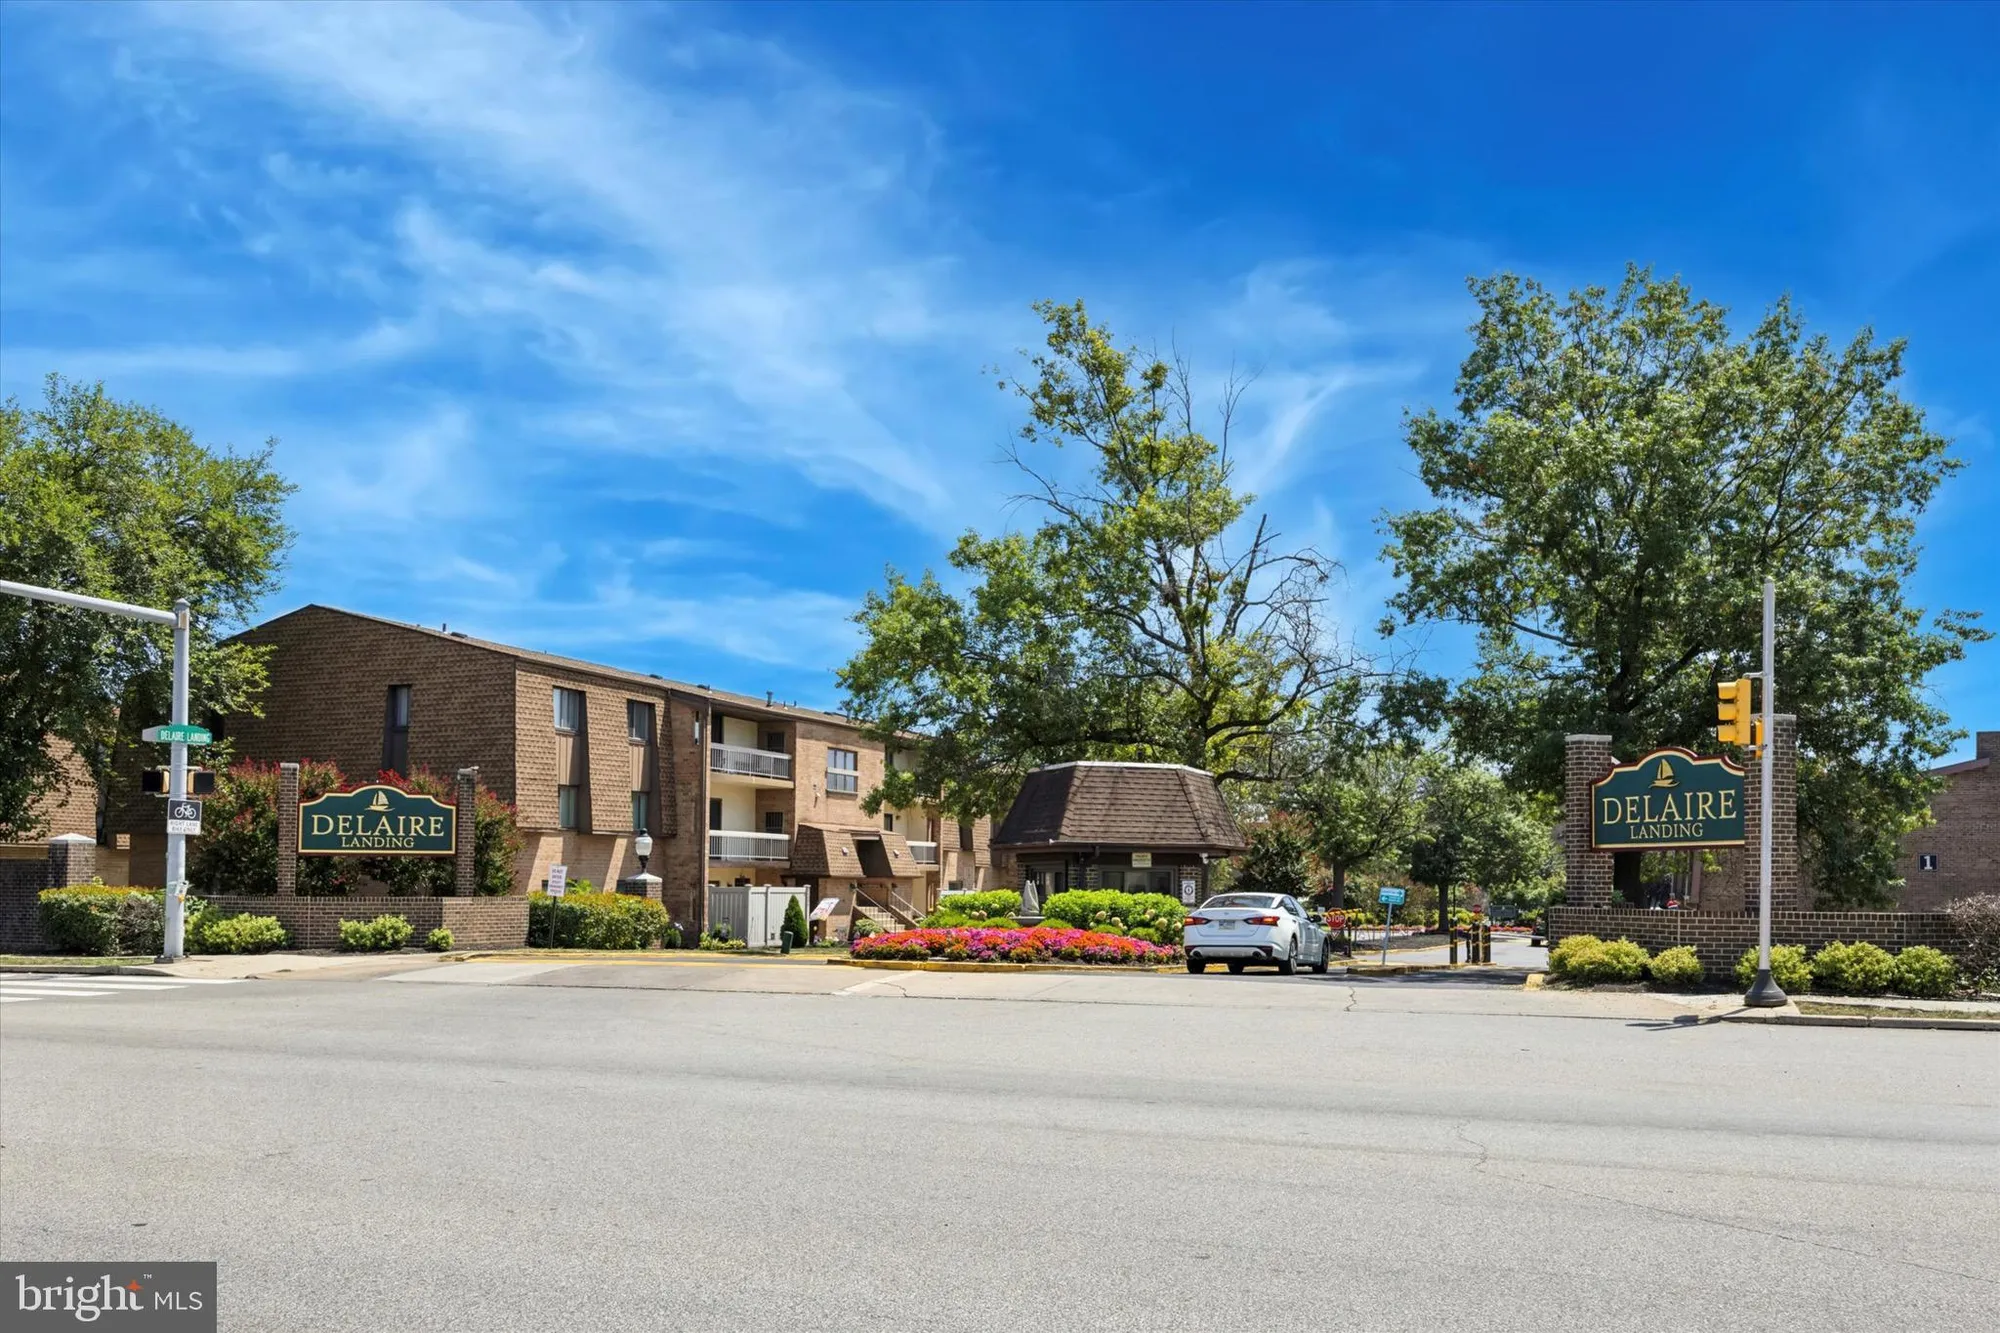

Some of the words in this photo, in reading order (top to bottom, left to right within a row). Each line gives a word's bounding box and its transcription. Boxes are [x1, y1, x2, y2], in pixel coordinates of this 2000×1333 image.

[160, 730, 185, 741] DELAIRE
[187, 732, 210, 743] LANDING
[1602, 789, 1737, 825] DELAIRE
[311, 815, 445, 837] DELAIRE
[1630, 823, 1703, 839] LANDING
[341, 837, 415, 848] LANDING
[1924, 855, 1933, 870] 1
[1326, 915, 1345, 923] STOP
